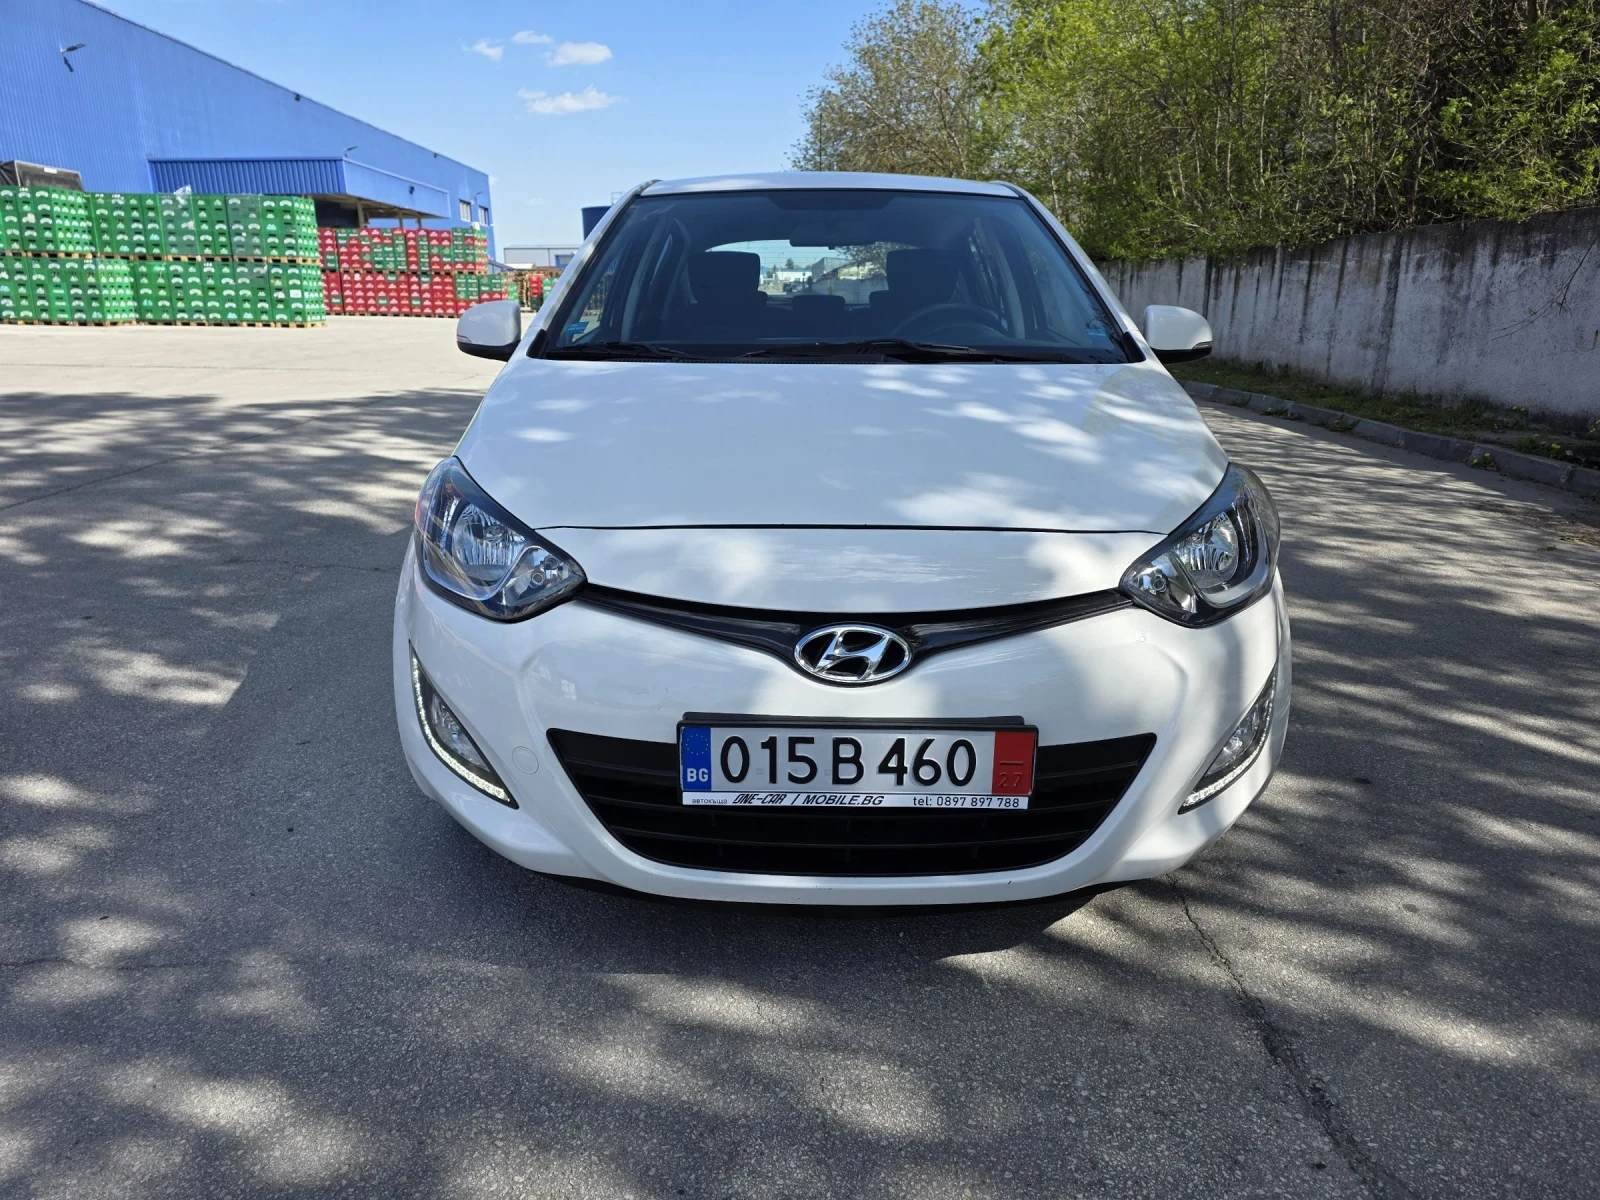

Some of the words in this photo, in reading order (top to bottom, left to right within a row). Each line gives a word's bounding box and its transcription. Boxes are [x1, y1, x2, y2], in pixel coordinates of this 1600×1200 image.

[720, 735, 818, 785] 015
[877, 737, 977, 787] 460
[686, 767, 709, 782] BG
[998, 771, 1023, 787] 27
[732, 793, 788, 804] ONE-CAR
[802, 794, 885, 806] MOBILE.BG
[912, 796, 932, 806] tel:
[936, 796, 967, 807] 0897
[970, 797, 993, 807] 897
[997, 797, 1020, 808] 788
